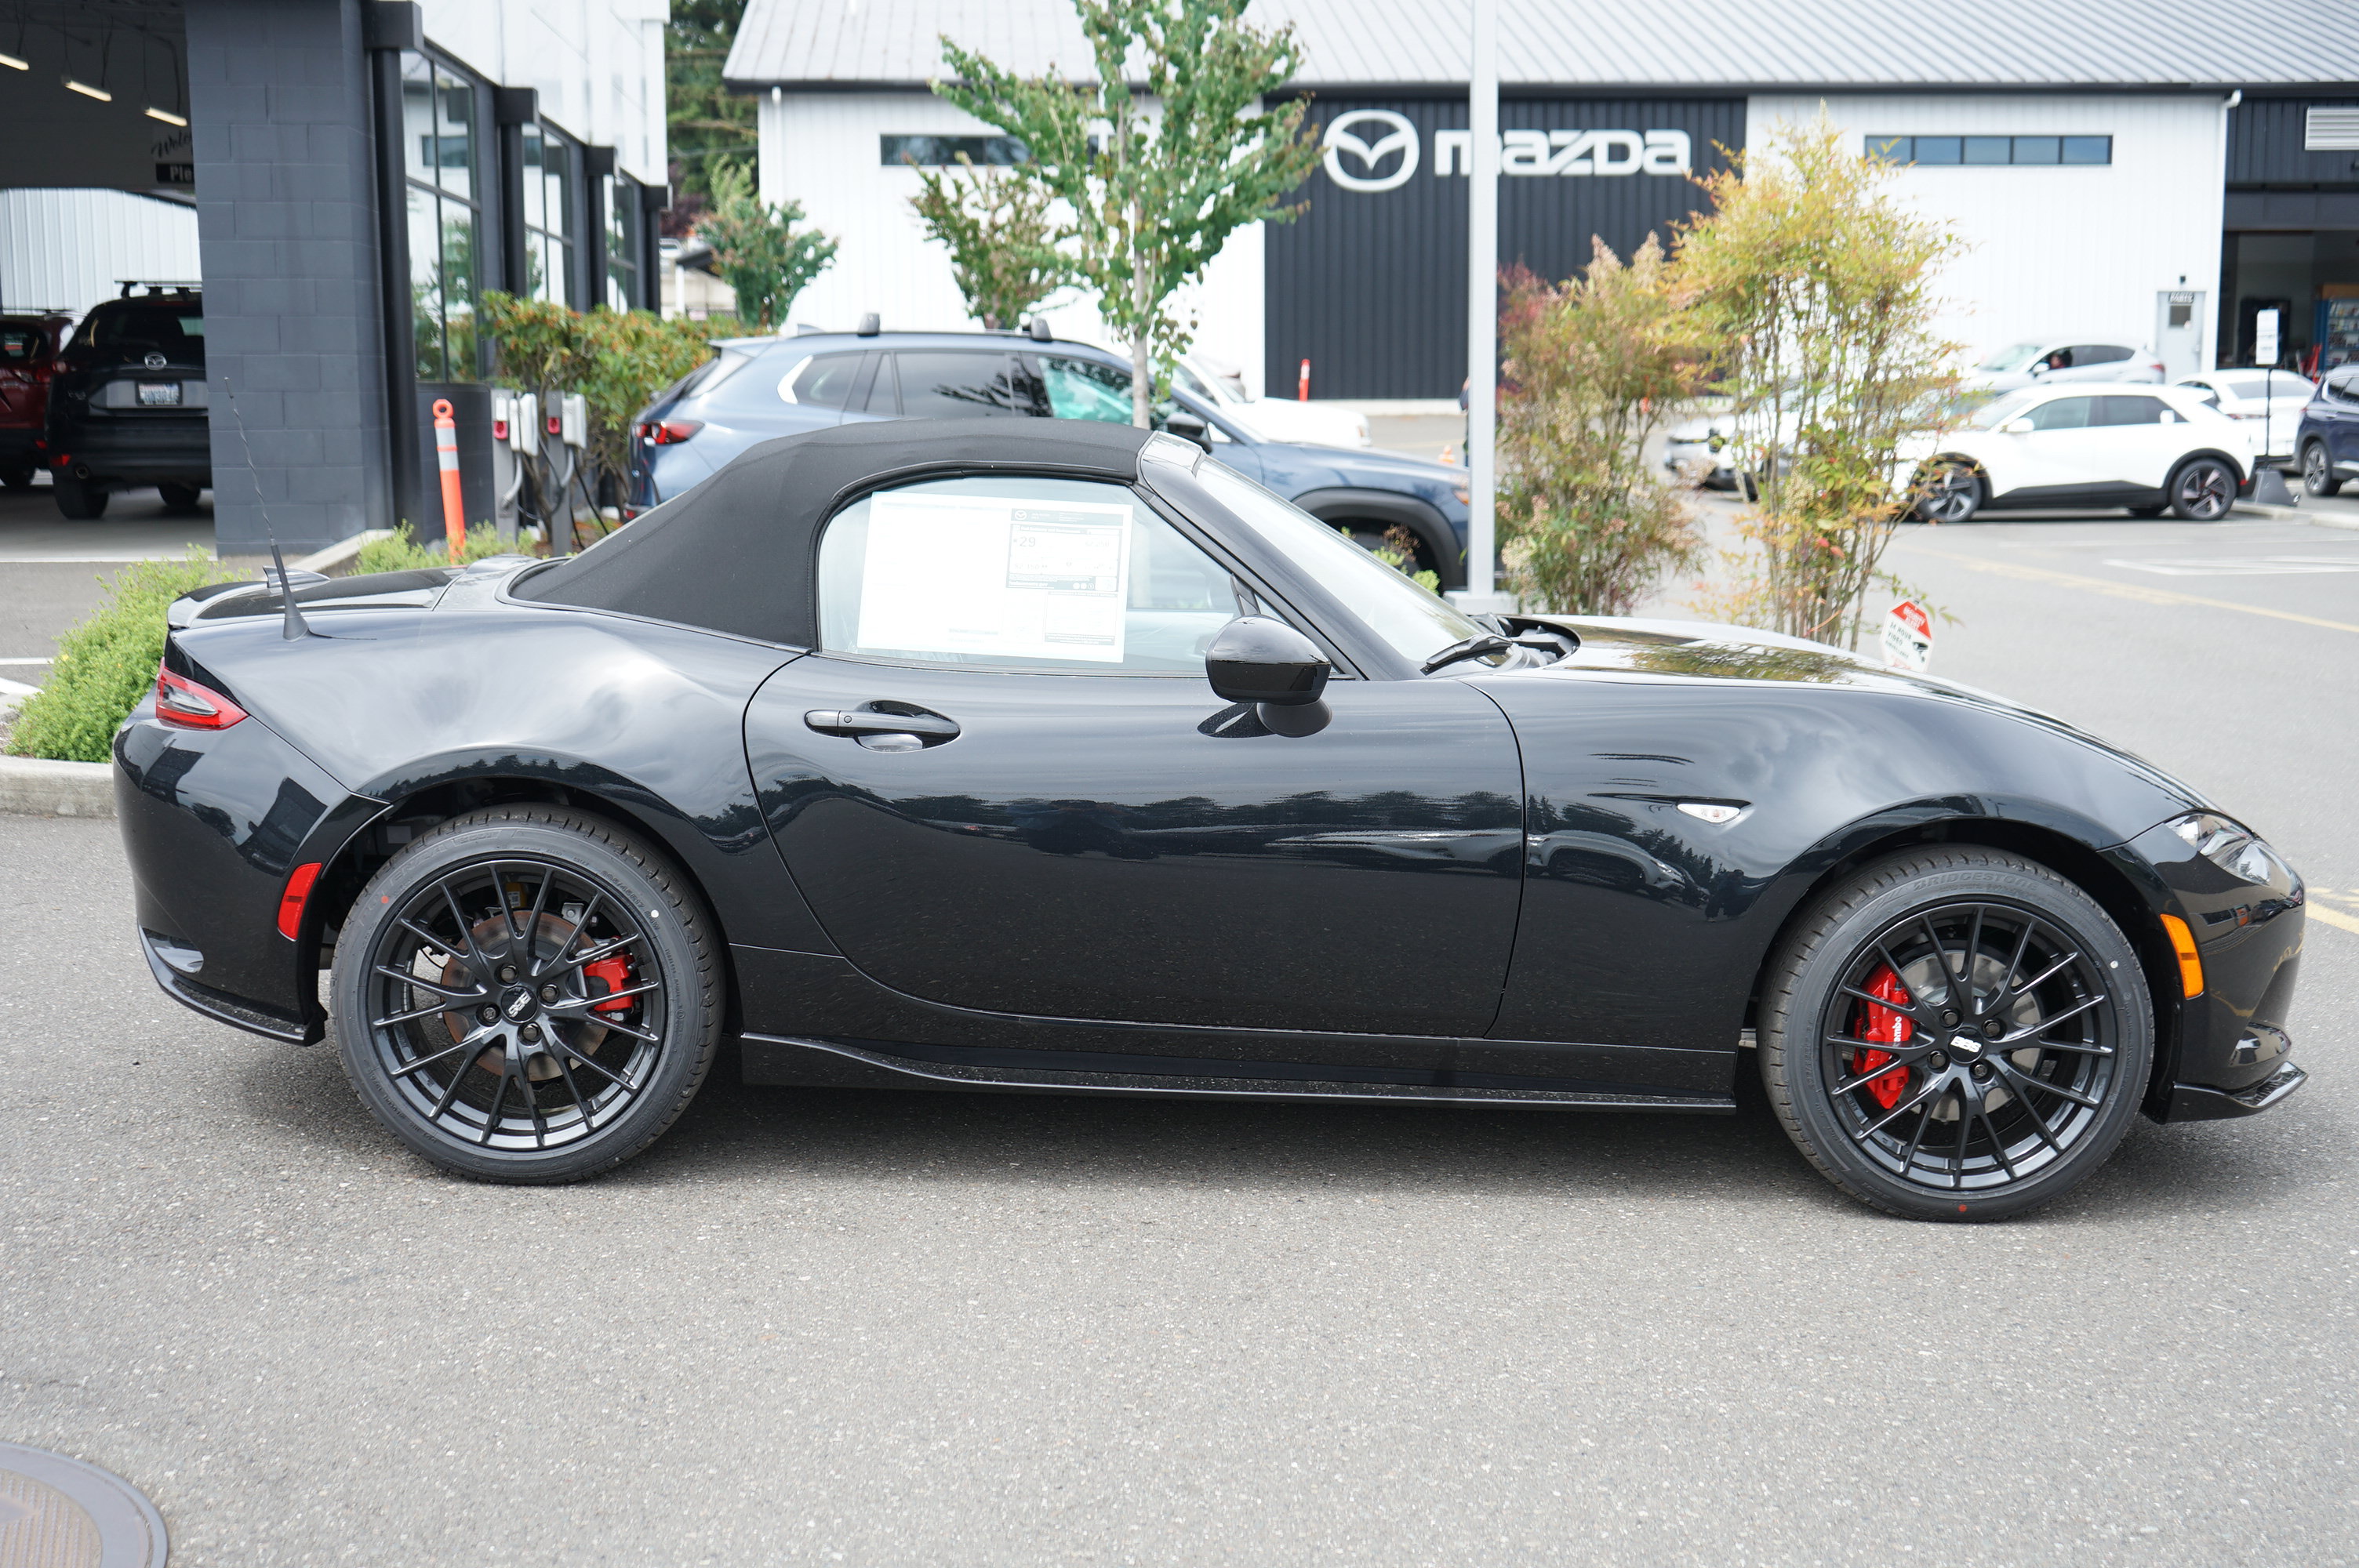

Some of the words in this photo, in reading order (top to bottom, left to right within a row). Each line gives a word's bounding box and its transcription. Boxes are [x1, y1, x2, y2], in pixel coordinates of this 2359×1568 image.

[1434, 129, 1692, 177] mazda
[1020, 536, 1036, 547] 29
[1913, 869, 2040, 892] BRIDGESTONE
[508, 990, 532, 1018] BBS
[1892, 1016, 1903, 1043] embo
[1950, 1036, 1982, 1053] BBS
